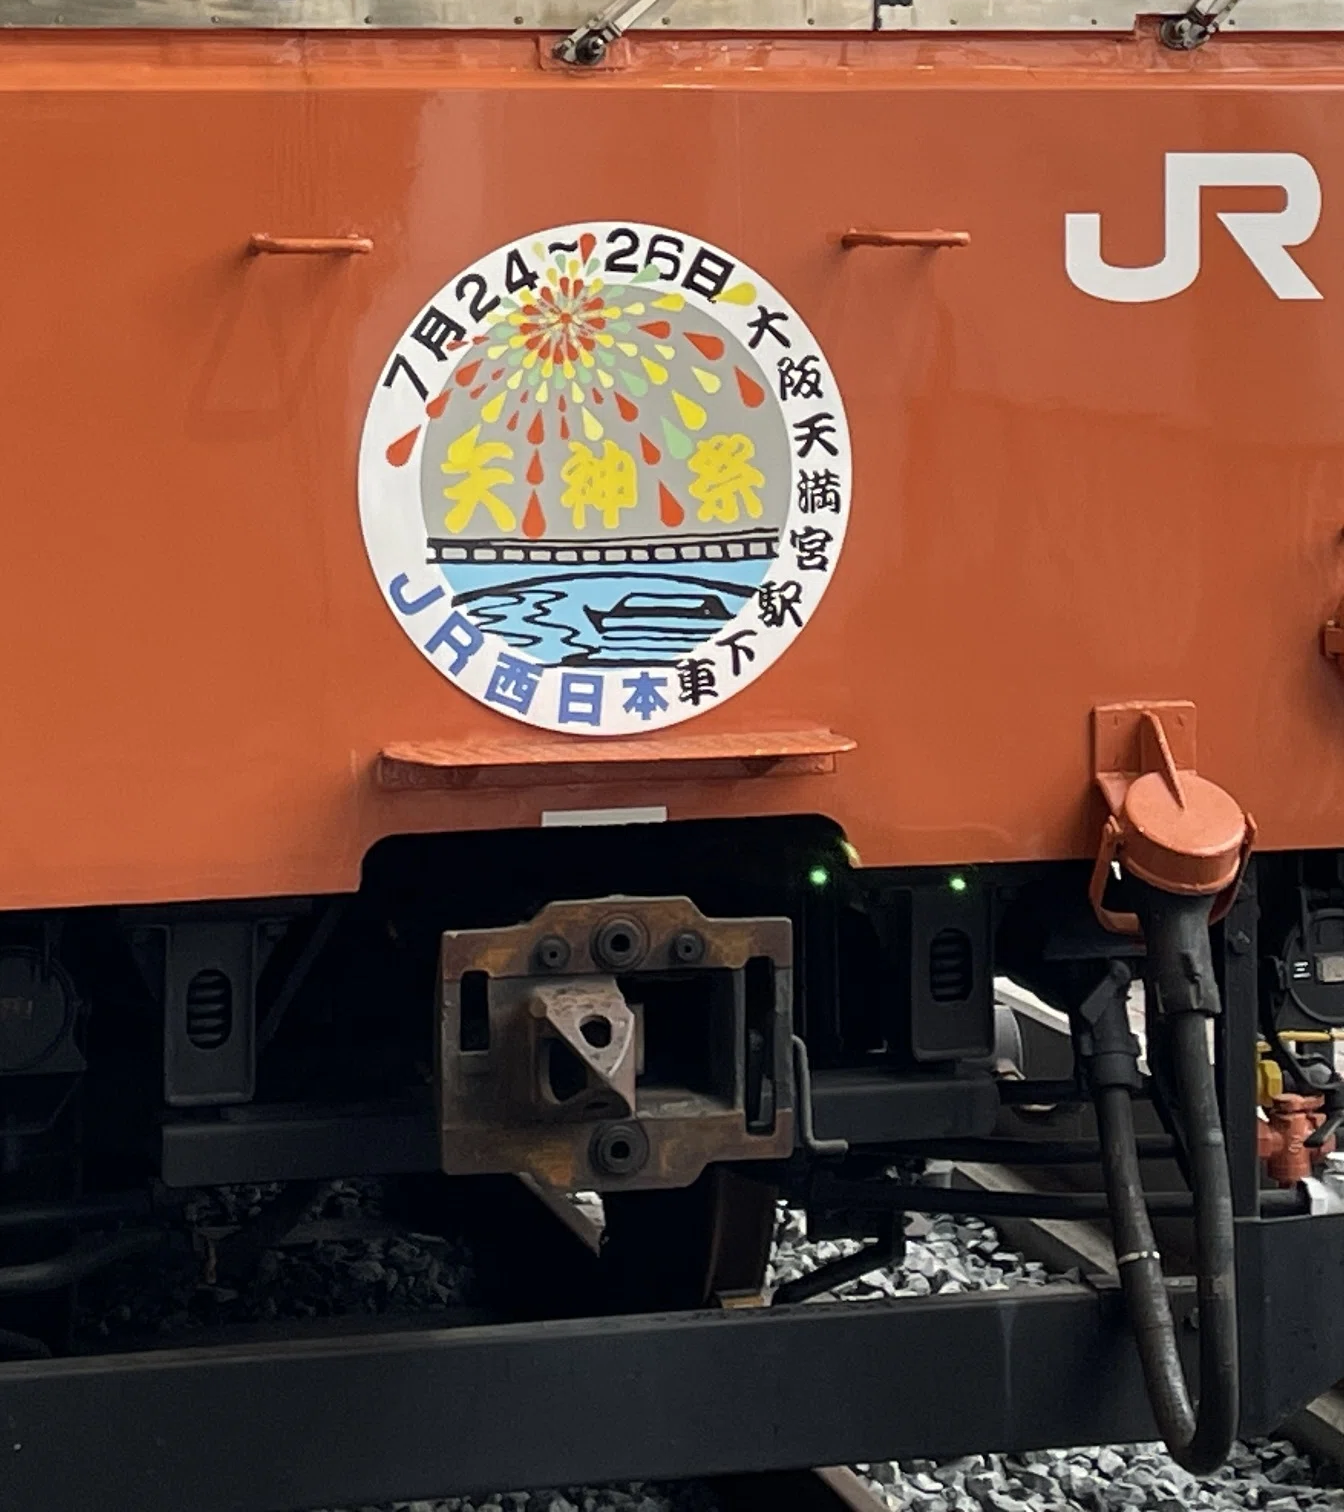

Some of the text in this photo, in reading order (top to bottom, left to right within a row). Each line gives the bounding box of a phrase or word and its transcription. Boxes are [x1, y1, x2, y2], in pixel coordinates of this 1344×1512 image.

[1065, 152, 1325, 303] JR
[676, 304, 842, 706] 大阪天満宮駅下車
[389, 572, 670, 726] JR西日本
